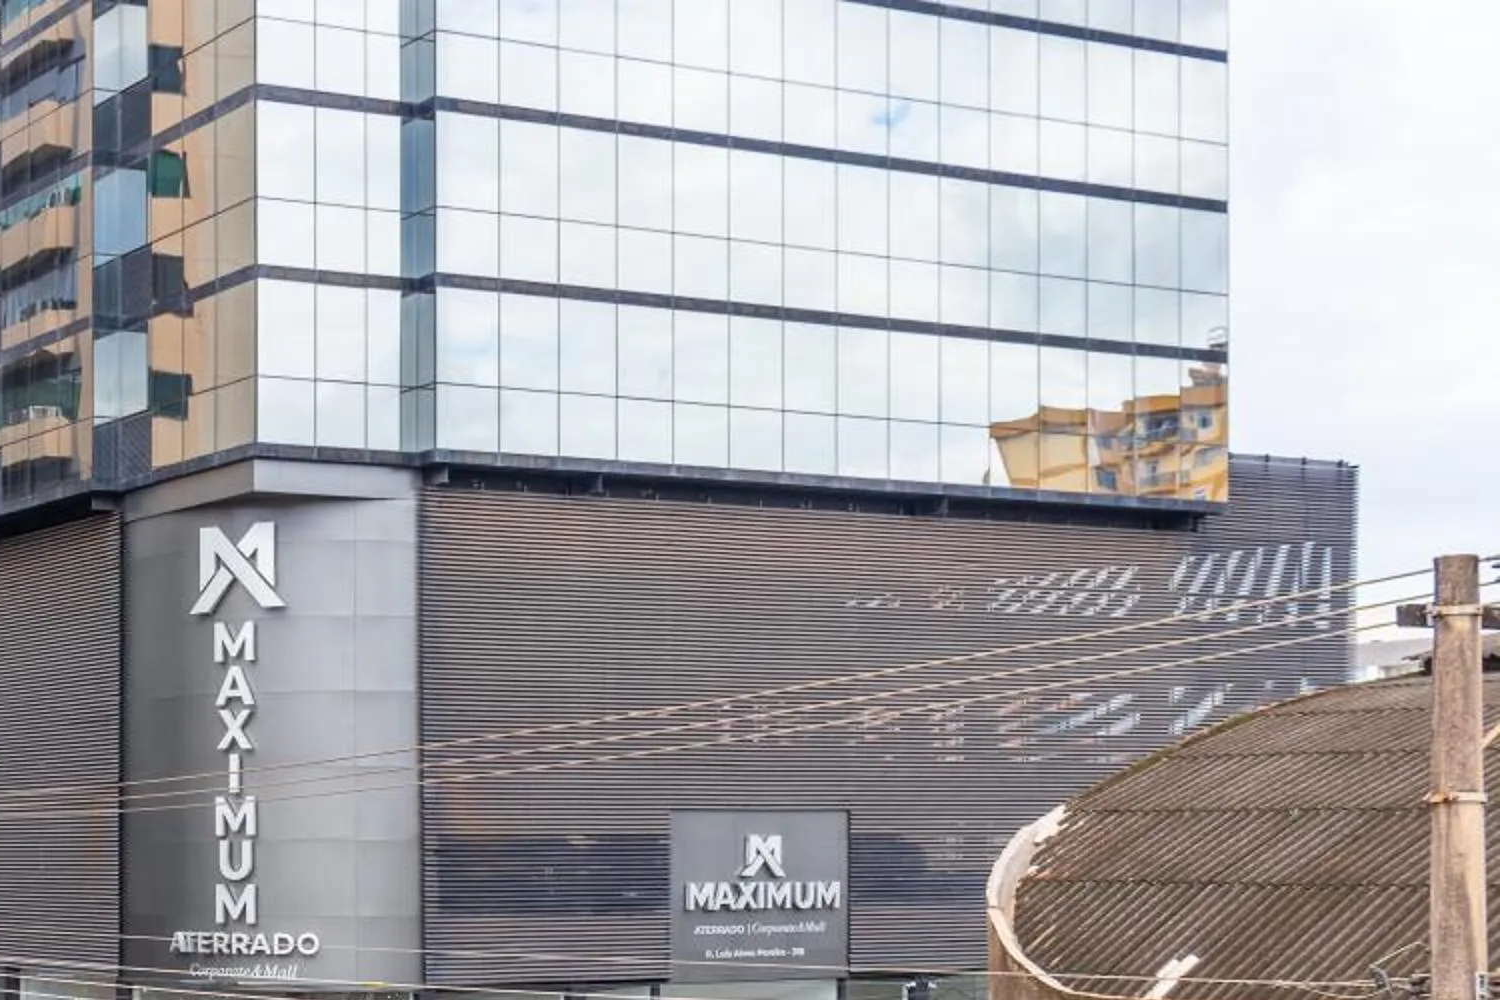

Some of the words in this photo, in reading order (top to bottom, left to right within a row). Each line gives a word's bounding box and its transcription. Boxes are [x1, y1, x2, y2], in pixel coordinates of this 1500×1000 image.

[212, 619, 258, 925] MAXIMUM
[685, 880, 842, 911] MAXIMUM
[169, 931, 320, 955] ATERRADO
